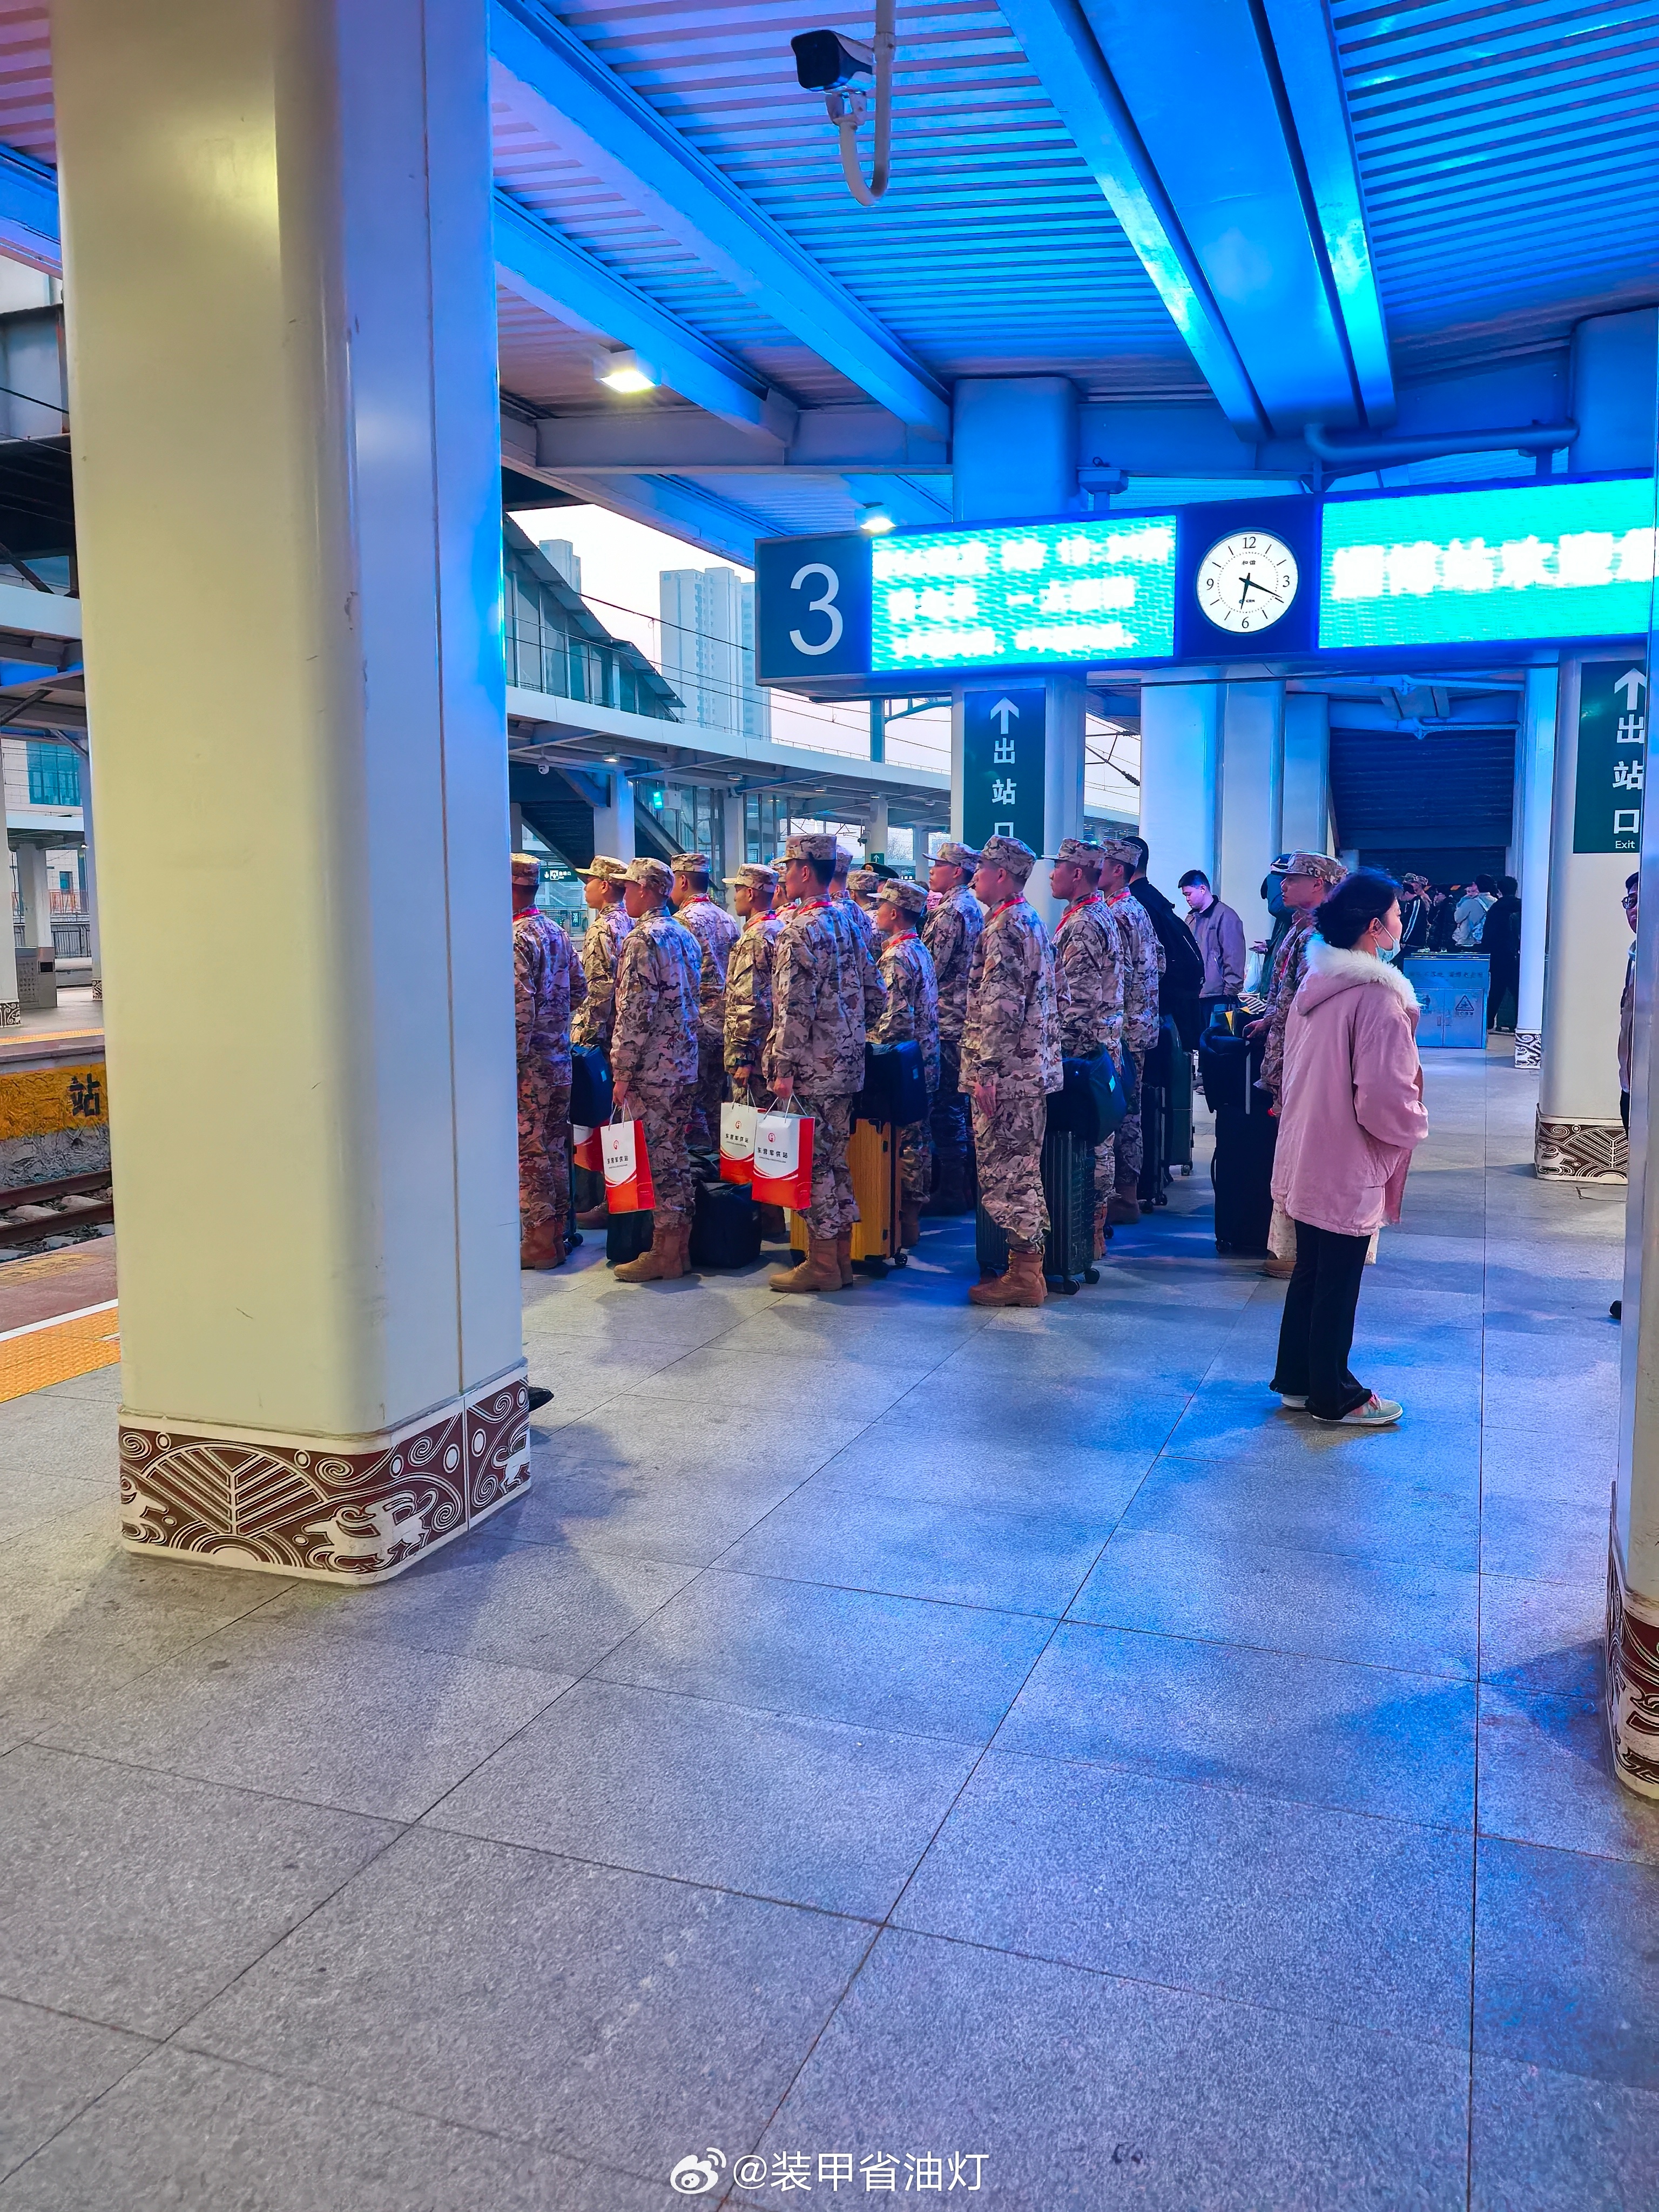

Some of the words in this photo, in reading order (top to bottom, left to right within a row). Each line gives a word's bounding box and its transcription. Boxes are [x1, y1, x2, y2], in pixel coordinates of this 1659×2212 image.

[1243, 536, 1256, 549] 12
[1206, 578, 1214, 590] 9
[1283, 575, 1290, 588] 3
[790, 563, 843, 655] 3
[1242, 617, 1249, 629] 6
[1613, 714, 1645, 834] 出站口
[992, 737, 1017, 838] 出站口
[1615, 840, 1635, 849] Exit
[68, 1073, 100, 1117] 站
